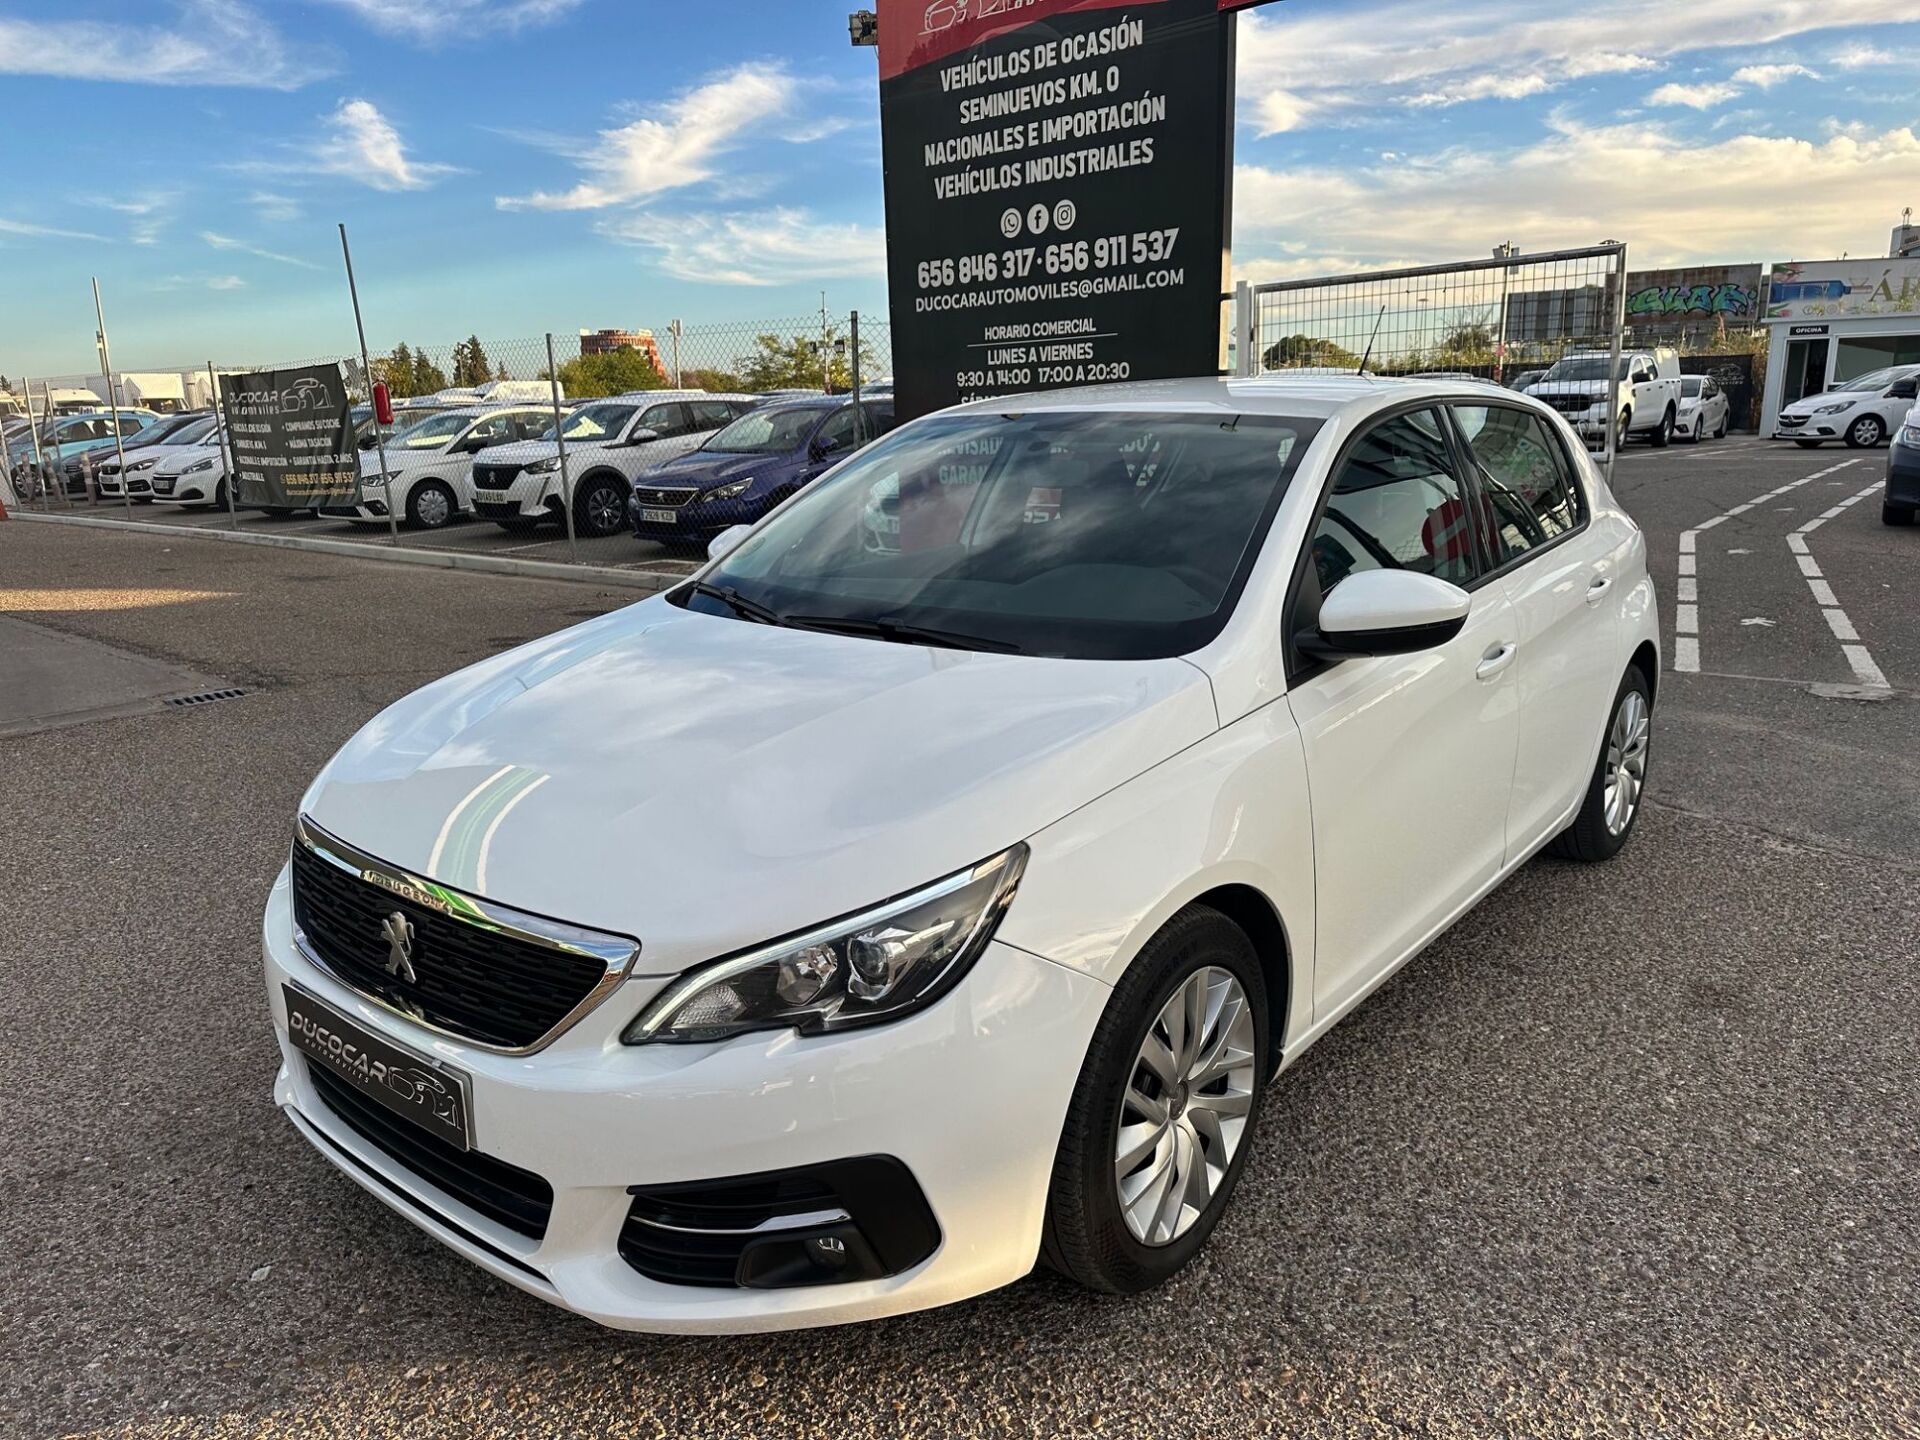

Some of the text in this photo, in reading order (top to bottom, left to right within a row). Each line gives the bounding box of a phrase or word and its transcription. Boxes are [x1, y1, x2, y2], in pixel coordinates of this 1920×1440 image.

[940, 16, 1143, 93] VEHÍCULOS DE OCASIÓN
[959, 79, 1066, 124] SEMINUEVOS
[1070, 73, 1103, 101] KM.
[924, 91, 1166, 167] NACIONALES E IMPORTACIÓN
[934, 138, 1154, 199] VEHÍCULOS INDUSTRIALES
[917, 258, 954, 289] 656
[958, 253, 997, 284] 846
[1094, 235, 1126, 267] 911
[1131, 227, 1180, 264] 537
[915, 268, 1184, 313] DUCOCARAUTOMOVILES@GMAIL.COM
[984, 317, 1096, 341] HORARIO COMERCIAL
[987, 343, 1094, 366] LUNES A VIERNES
[956, 361, 1130, 387] 9:30 A 14:00 17:00 A 20:30
[289, 1011, 389, 1083] DUCOCAR
[305, 1038, 370, 1085] AUTOMOVILES
